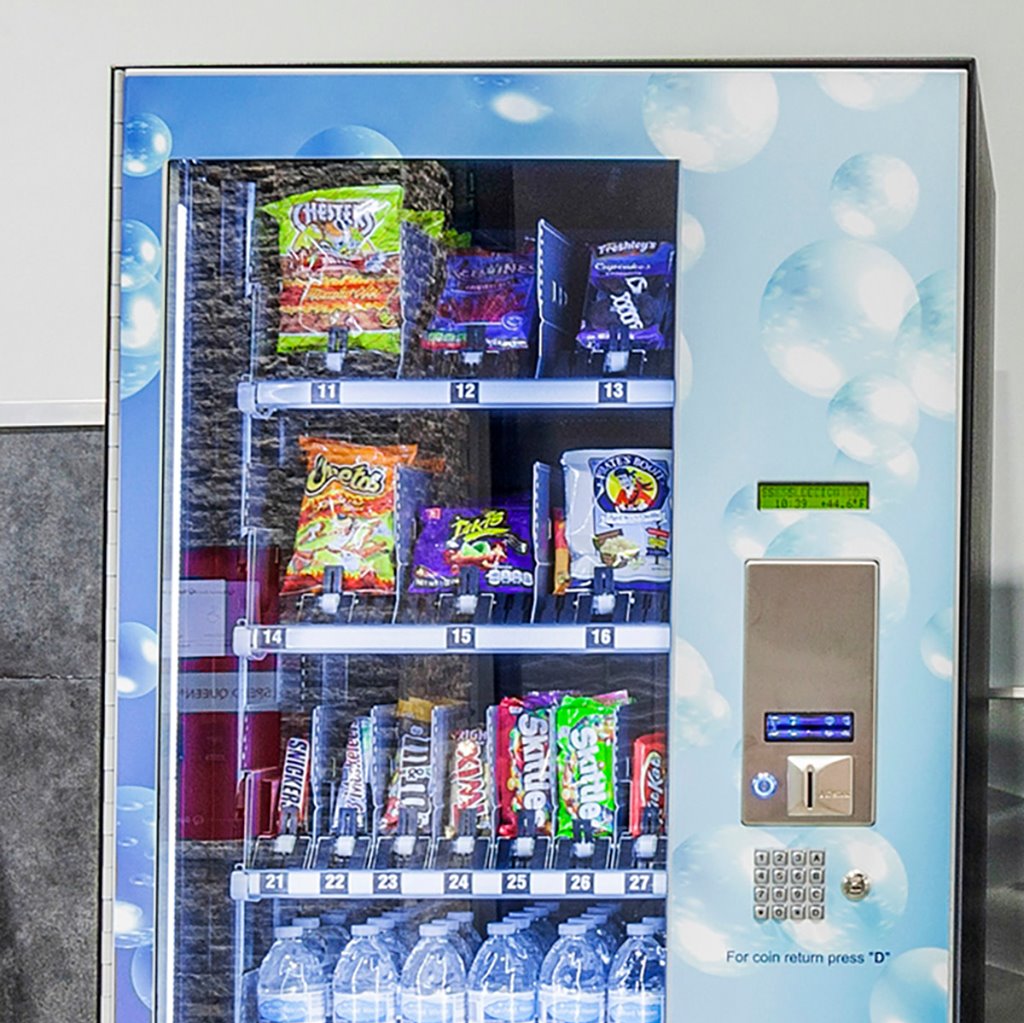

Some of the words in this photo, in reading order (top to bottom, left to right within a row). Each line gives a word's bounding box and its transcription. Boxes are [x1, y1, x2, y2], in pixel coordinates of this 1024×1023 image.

[317, 383, 336, 399] 11
[455, 382, 476, 399] 12
[603, 381, 624, 399] 13
[262, 628, 282, 645] 14
[451, 627, 472, 644] 15
[591, 628, 611, 645] 16
[570, 726, 609, 820] Skittle
[265, 873, 284, 890] 21
[324, 873, 345, 890] 22
[377, 874, 398, 890] 23
[448, 874, 469, 890] 24
[506, 874, 527, 890] 25
[570, 874, 591, 891] 26
[629, 874, 650, 891] 27
[726, 951, 748, 963] For
[752, 951, 780, 963] coin
[784, 951, 823, 963] return
[828, 953, 864, 966] press
[868, 951, 890, 963] "D"
